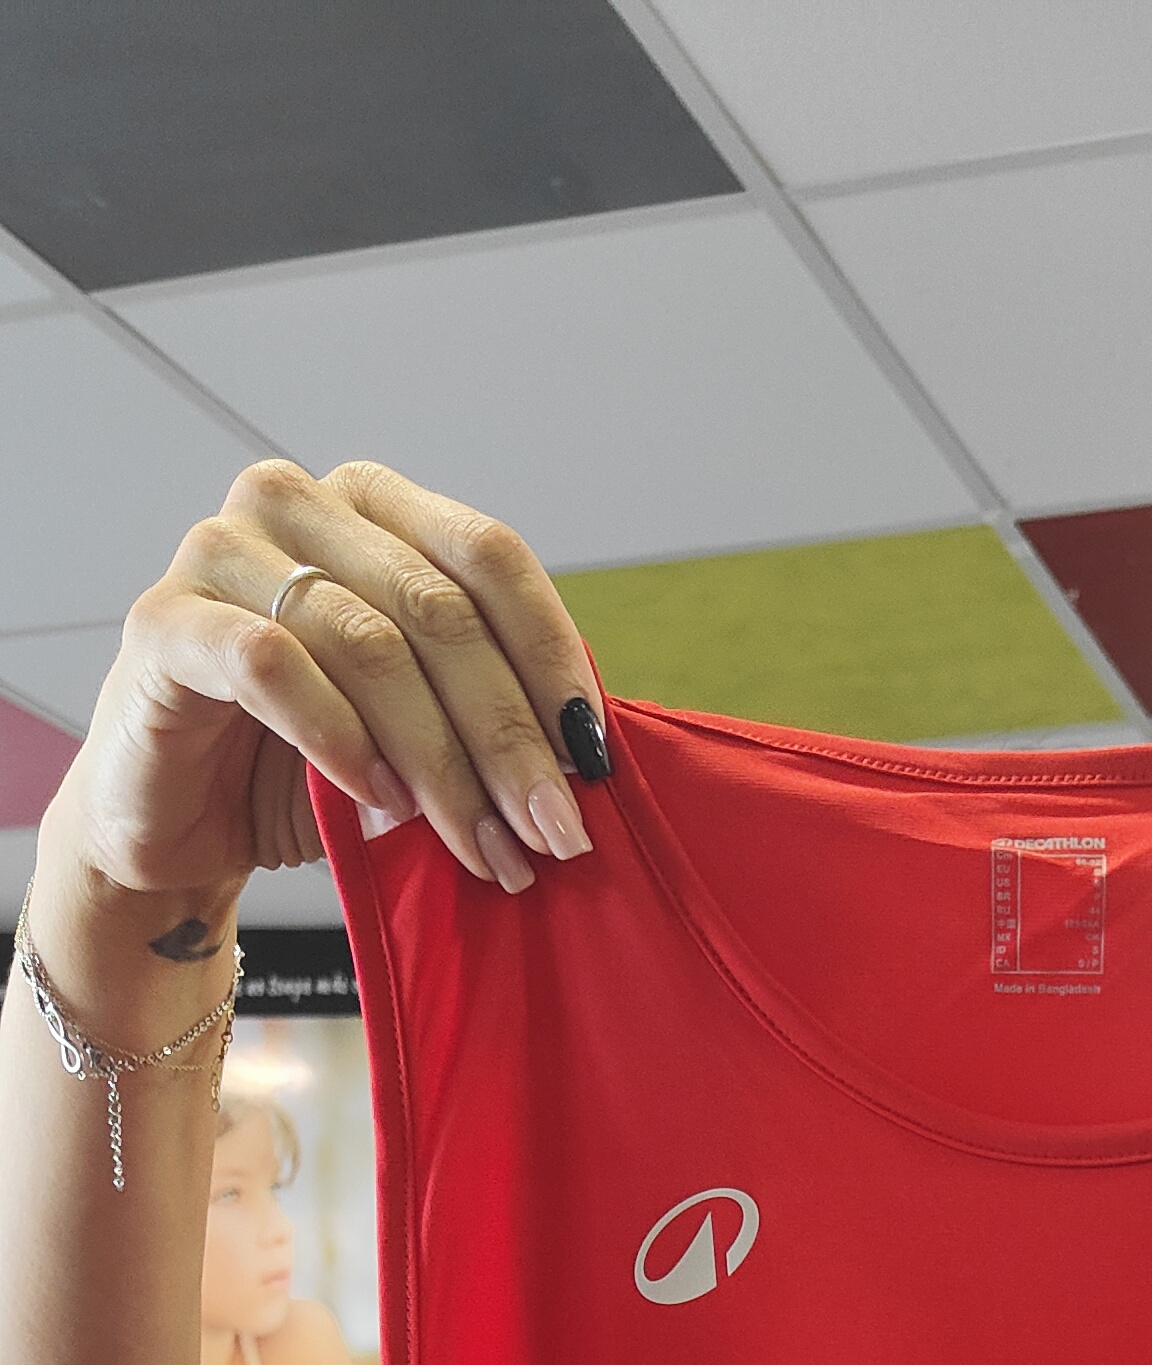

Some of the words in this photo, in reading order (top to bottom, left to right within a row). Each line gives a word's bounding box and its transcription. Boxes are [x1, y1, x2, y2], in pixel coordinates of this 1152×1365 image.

[1014, 837, 1106, 850] DECATHLON
[994, 982, 1023, 994] Made
[1024, 983, 1036, 994] in
[1038, 983, 1102, 997] Bangladesh
